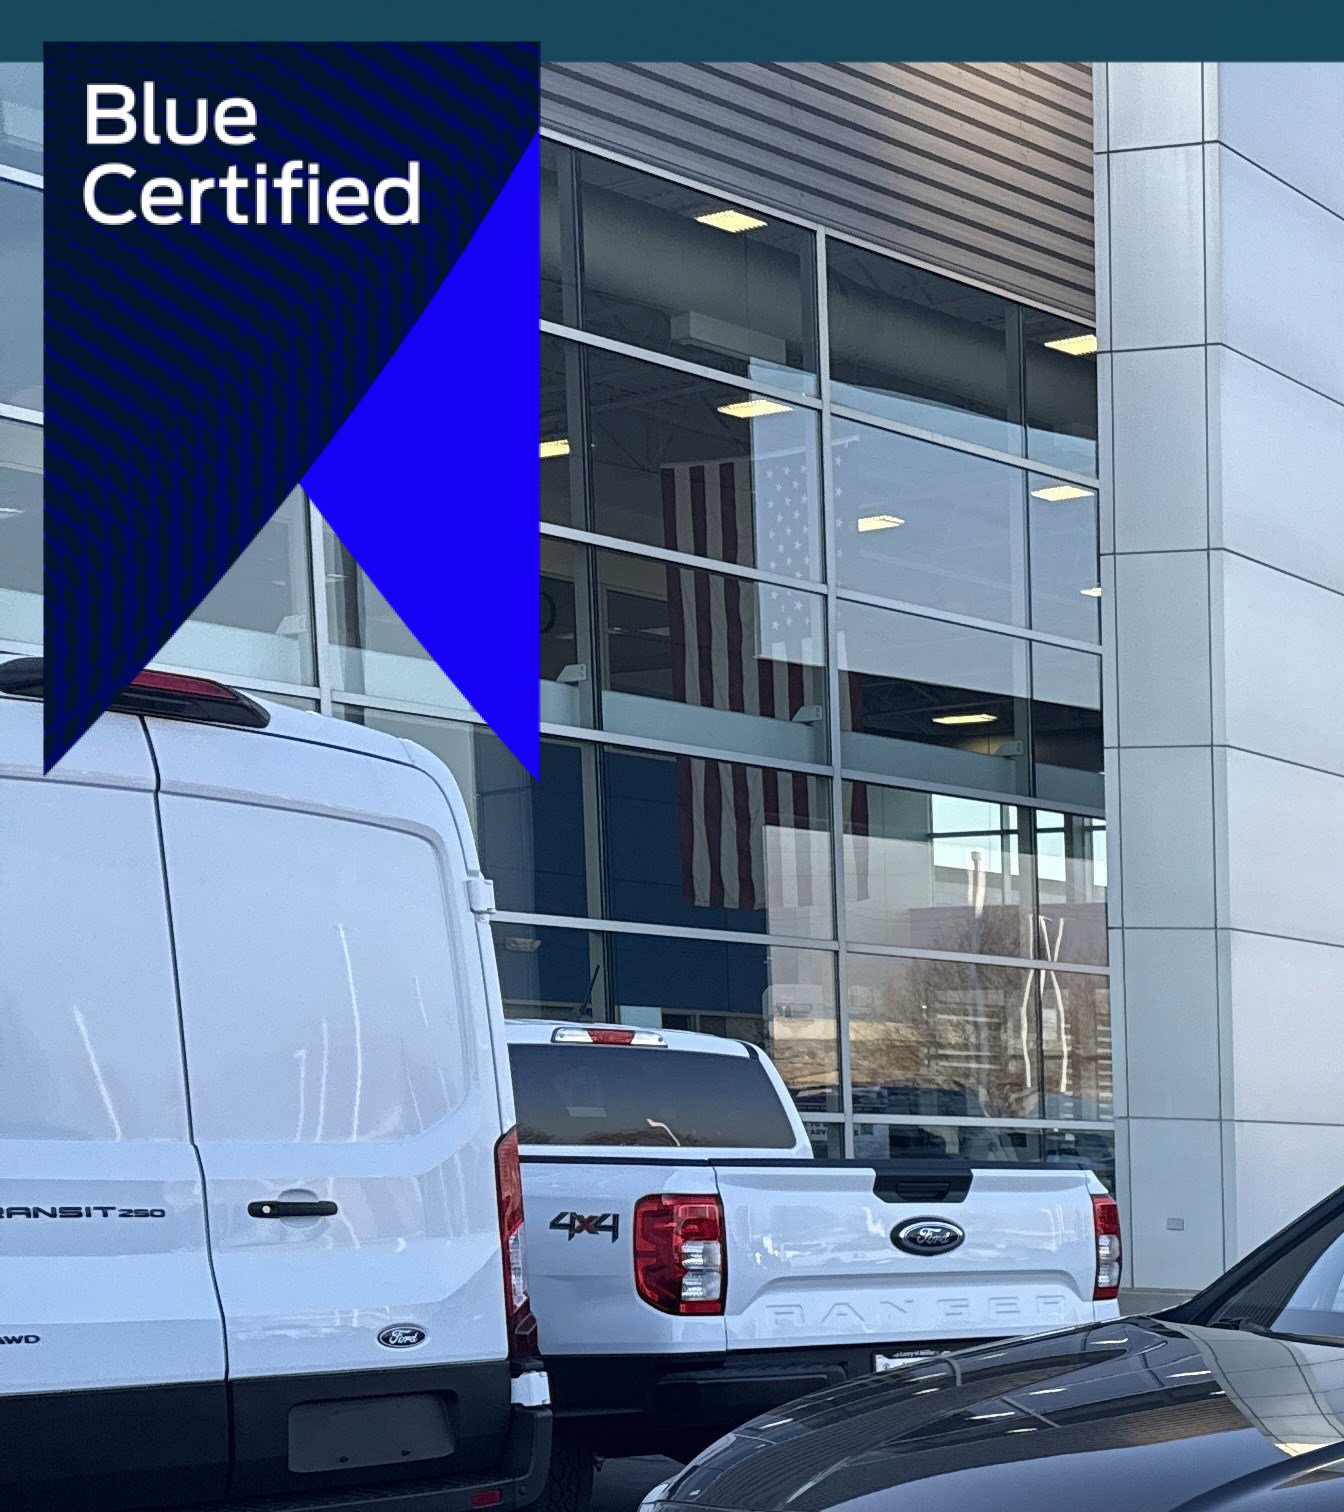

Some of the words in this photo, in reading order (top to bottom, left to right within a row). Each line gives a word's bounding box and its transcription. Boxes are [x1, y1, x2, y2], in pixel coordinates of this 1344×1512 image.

[0, 1206, 116, 1219] ANSIT
[118, 1208, 166, 1218] 250
[917, 1227, 951, 1245] Ford
[388, 1329, 419, 1345] Ford
